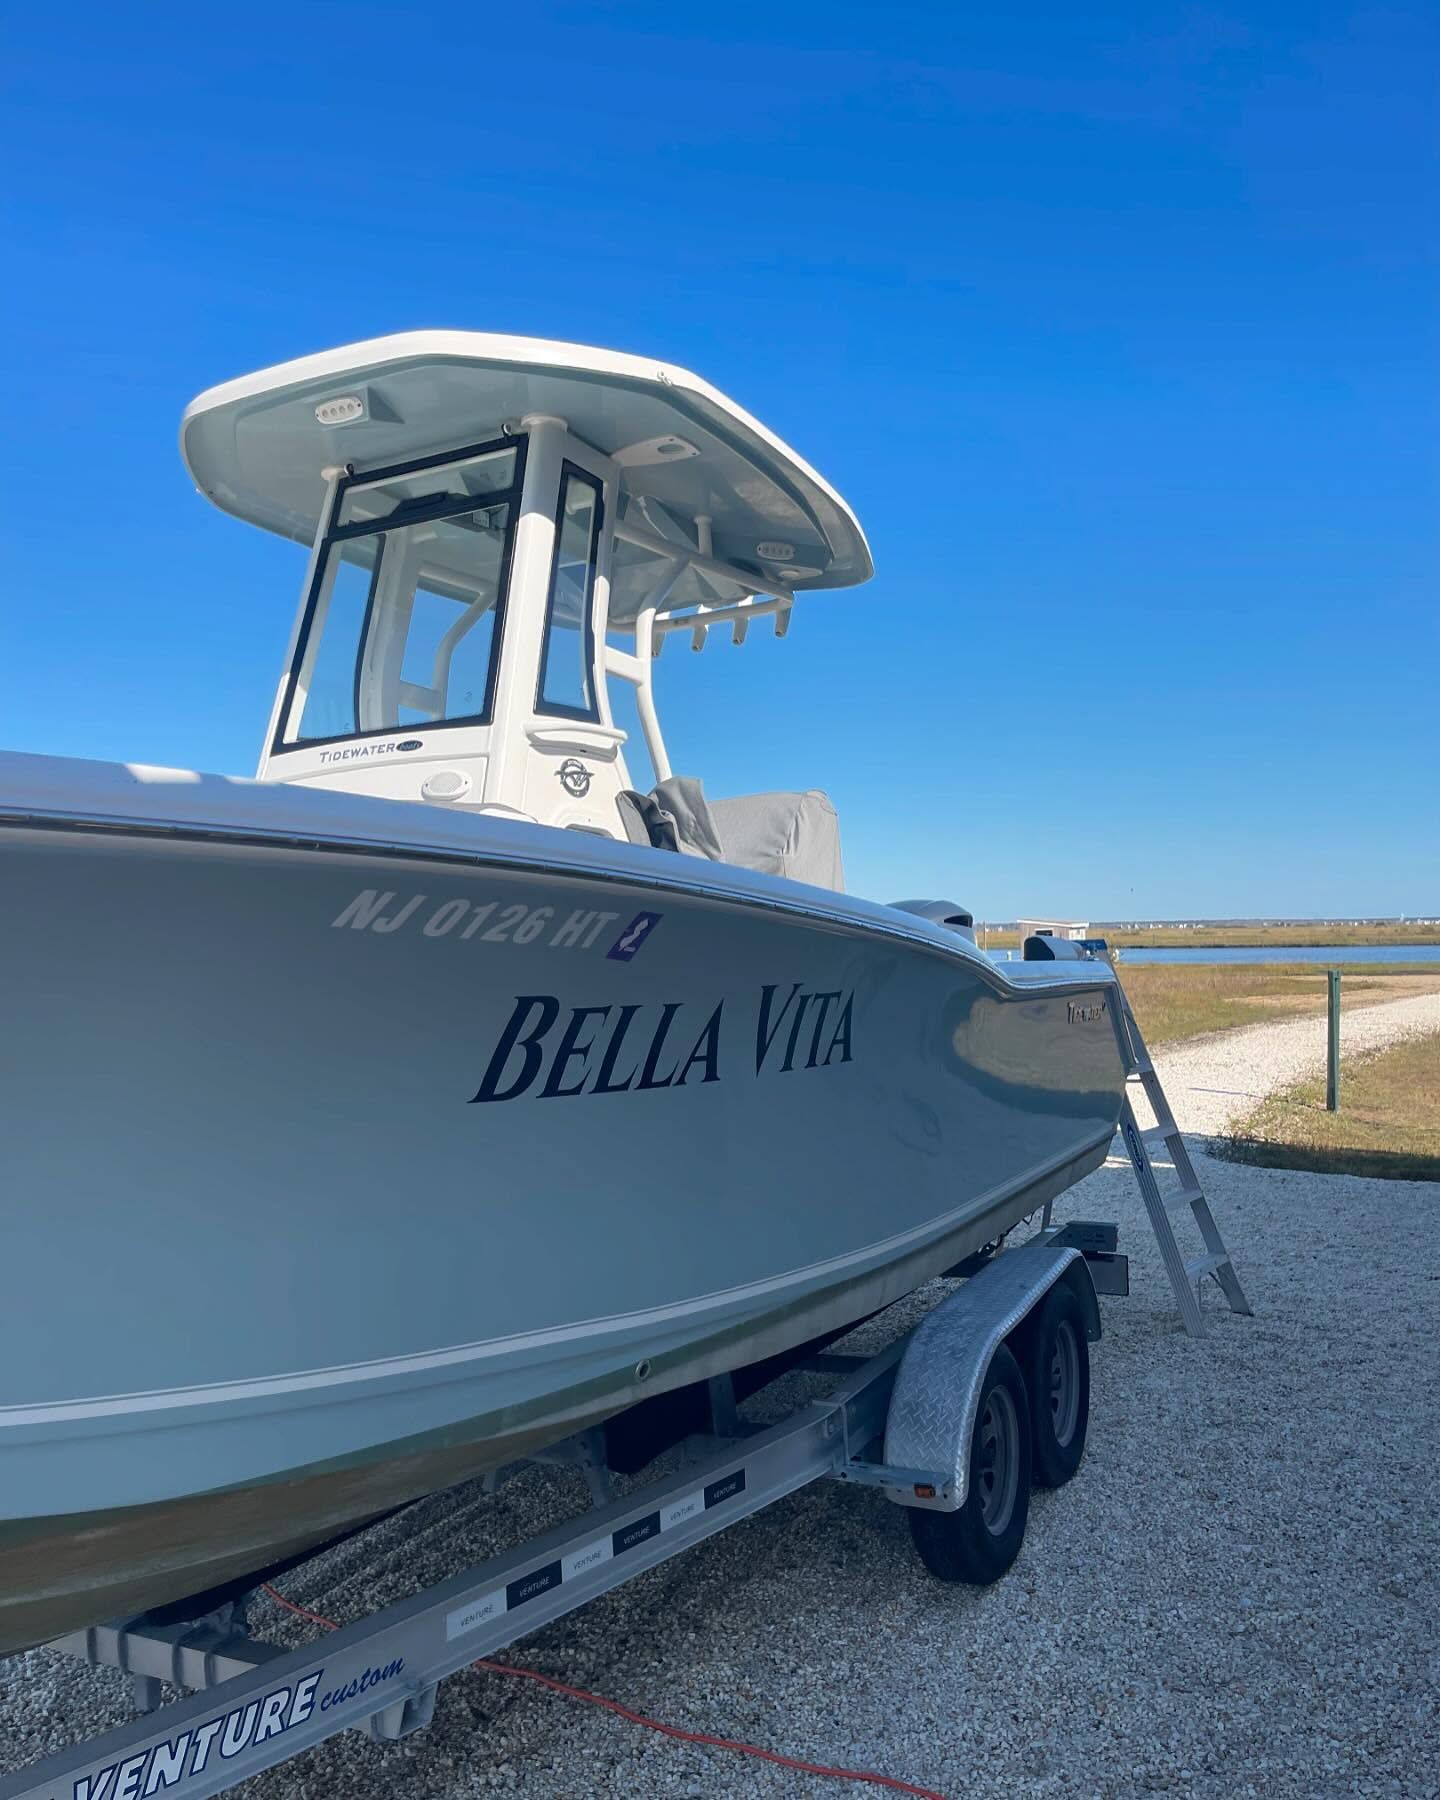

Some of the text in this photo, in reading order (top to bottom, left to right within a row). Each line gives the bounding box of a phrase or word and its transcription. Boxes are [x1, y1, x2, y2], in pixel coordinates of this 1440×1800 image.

[320, 743, 395, 763] TIDEWATER
[331, 889, 428, 932] NJ
[423, 899, 554, 944] 0126
[549, 910, 620, 948] HT
[467, 983, 855, 1103] BELLA VITA
[519, 1576, 550, 1598] VENTURE
[460, 1604, 494, 1628] VENTURE
[321, 1657, 405, 1711] custom
